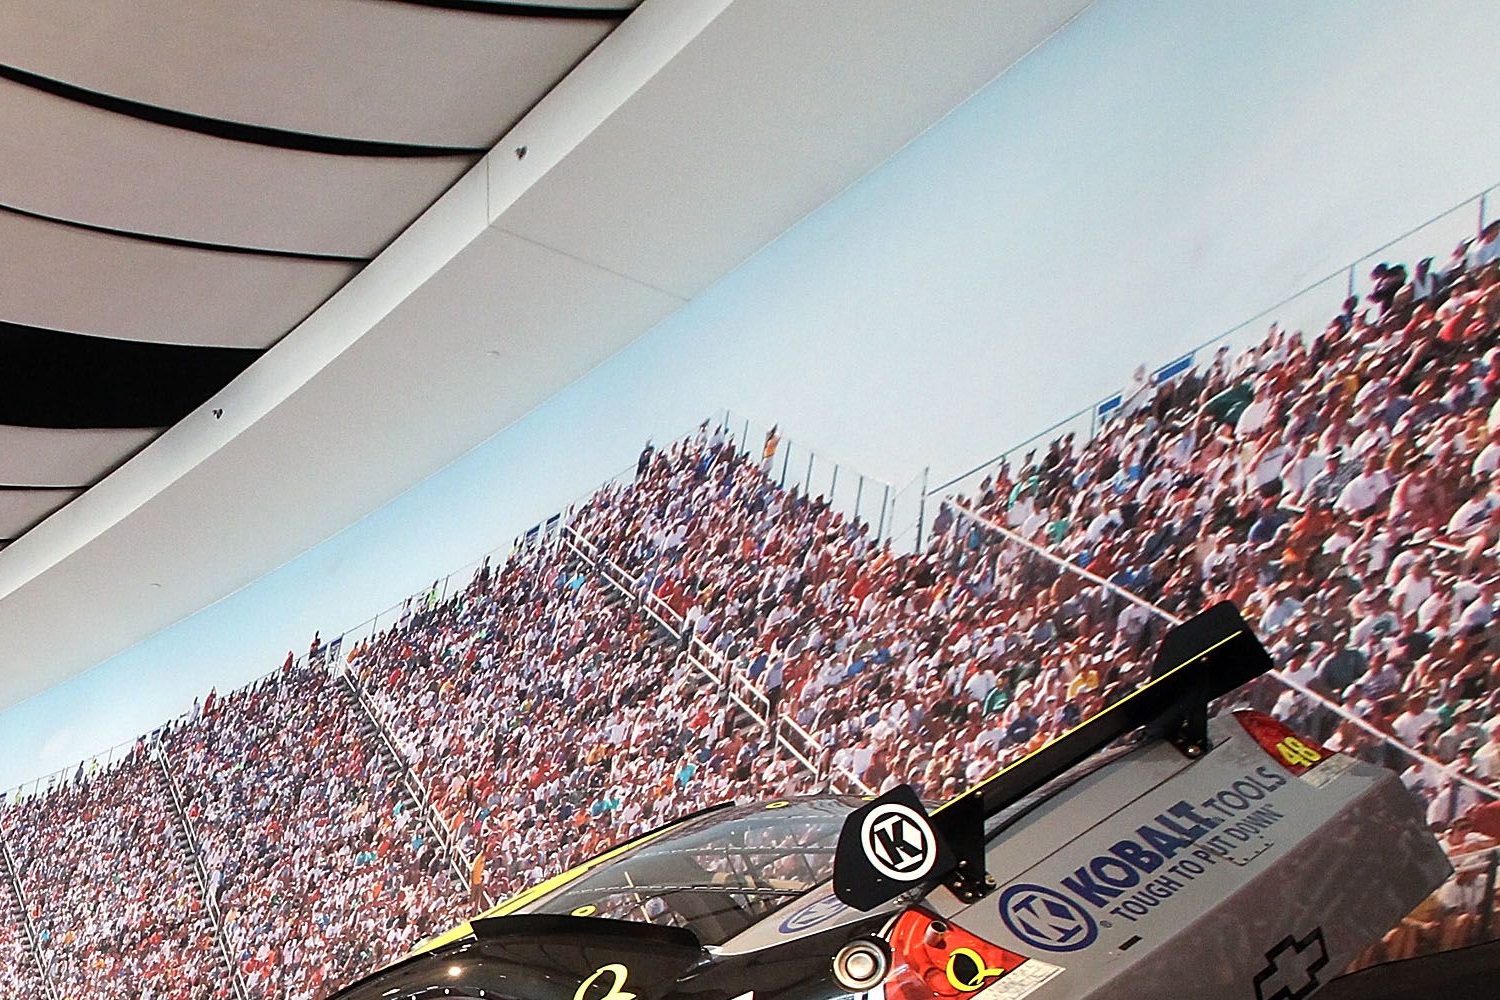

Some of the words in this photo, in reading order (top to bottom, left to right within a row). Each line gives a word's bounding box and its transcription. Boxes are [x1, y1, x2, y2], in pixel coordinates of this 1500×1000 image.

[1276, 736, 1322, 768] 48
[1060, 800, 1225, 908] KOBALT
[1201, 766, 1288, 822] TOOLS
[1109, 870, 1184, 922] TOUGH
[1168, 859, 1206, 881] TO
[1196, 835, 1238, 866] PUT
[1233, 808, 1285, 842] DOWN
[946, 947, 1005, 993] Q
